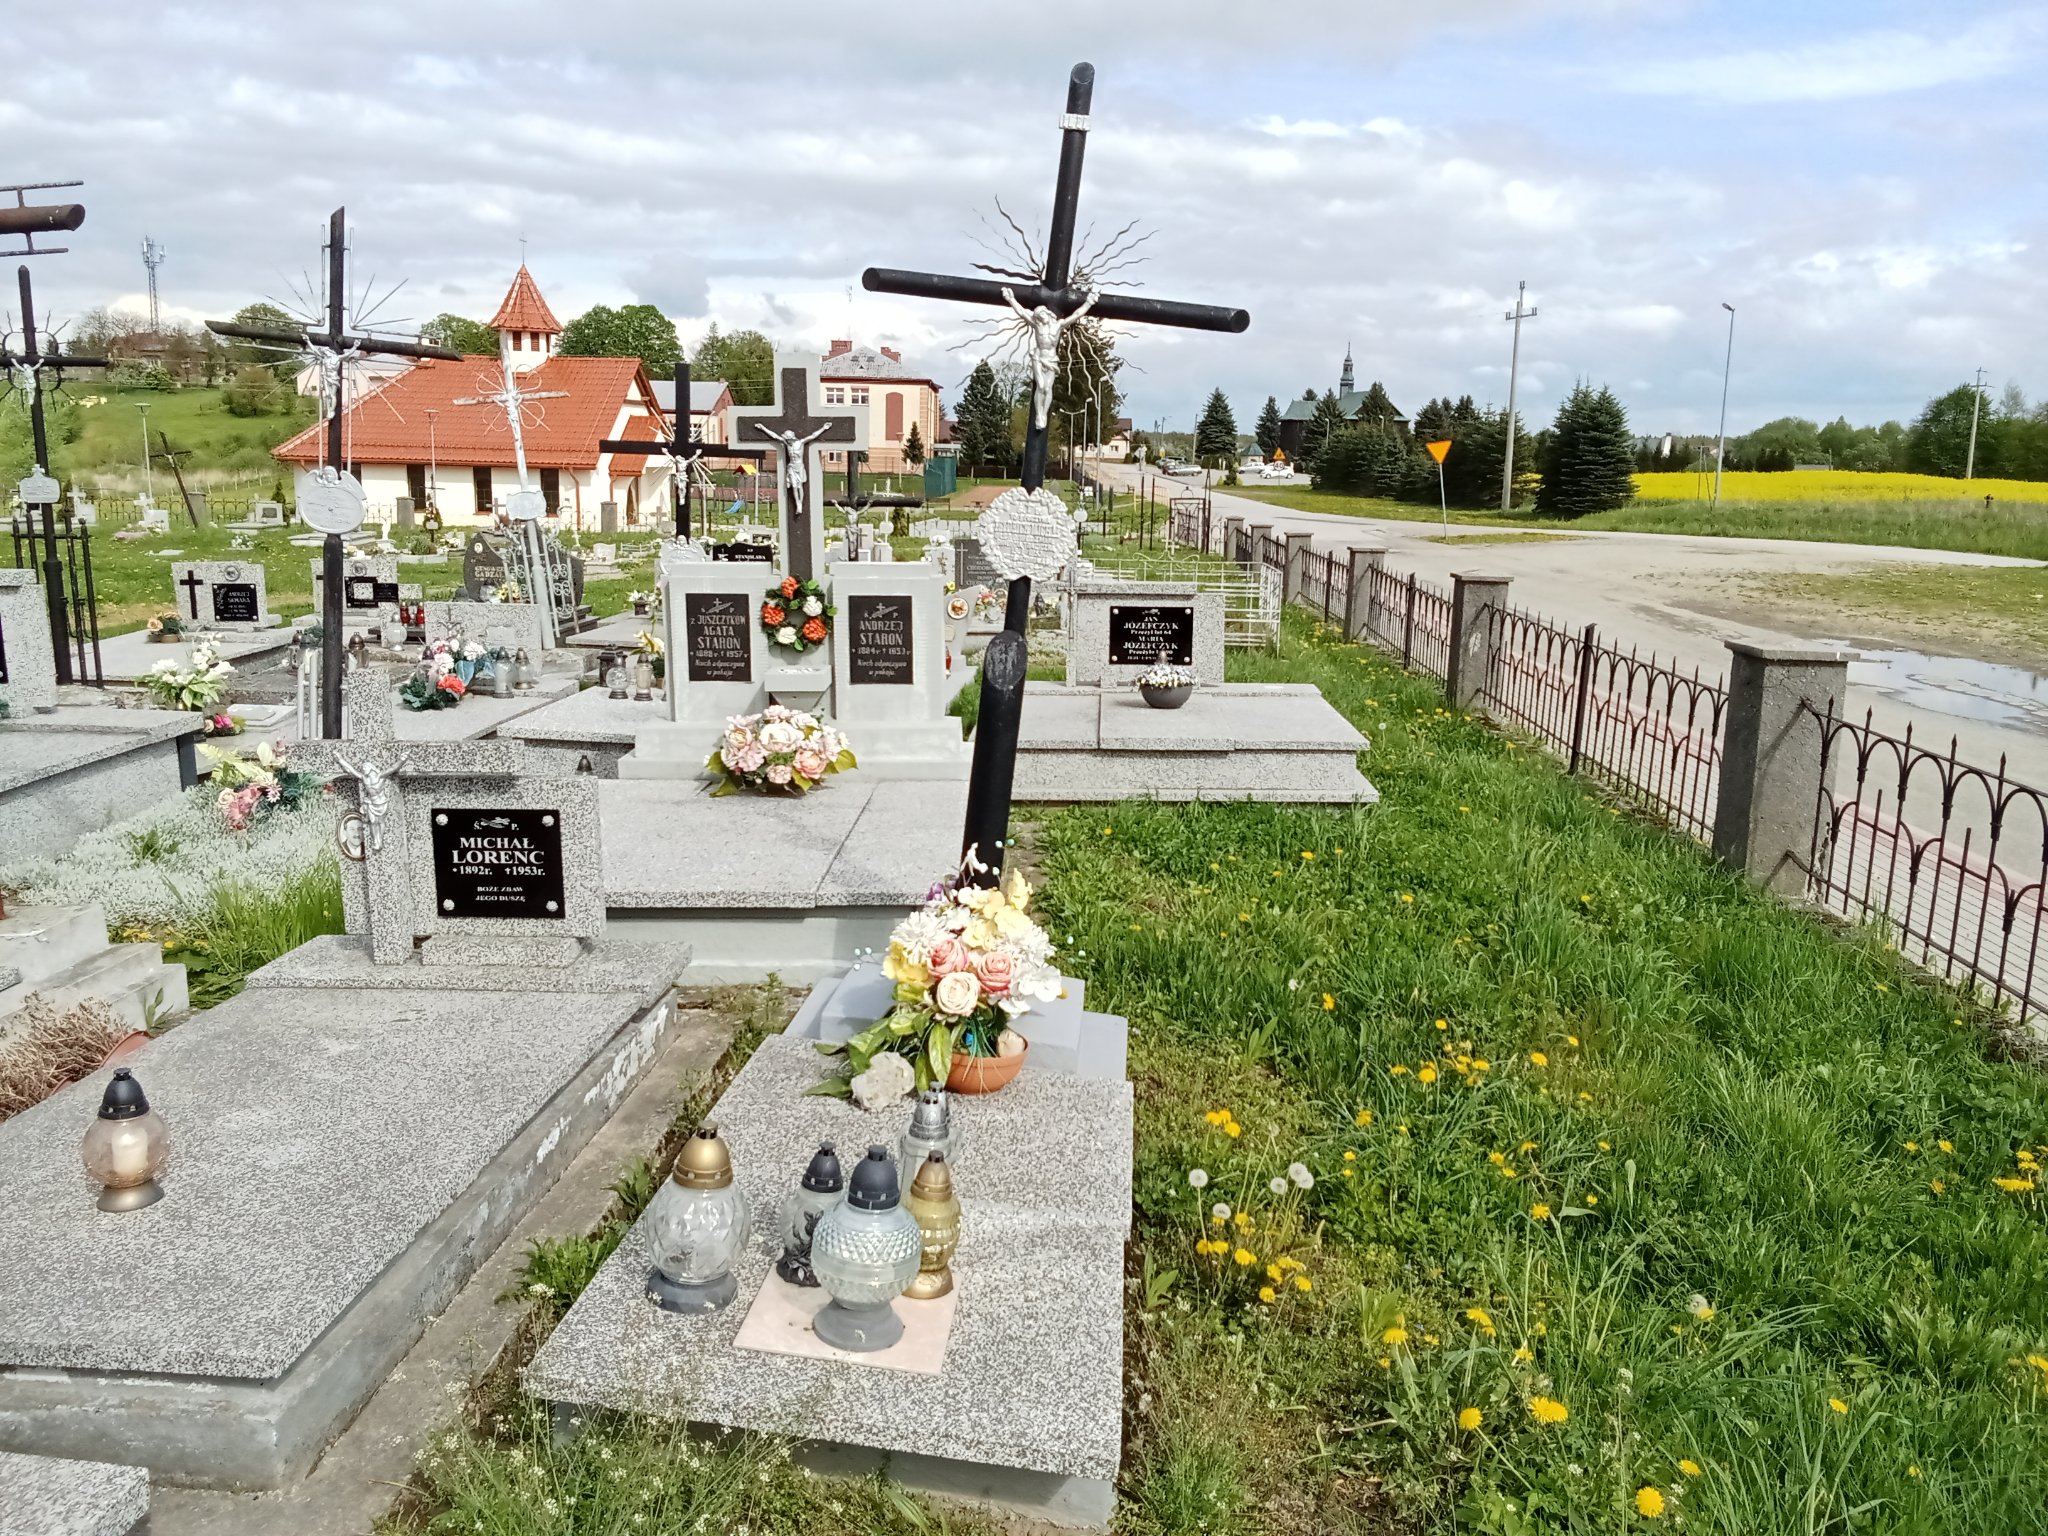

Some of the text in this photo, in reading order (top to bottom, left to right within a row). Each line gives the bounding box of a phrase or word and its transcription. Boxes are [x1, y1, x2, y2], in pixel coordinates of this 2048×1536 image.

[703, 625, 735, 636] AGATA
[859, 620, 904, 631] ANDRZEJ
[459, 836, 535, 849] MICHAŁ
[451, 849, 545, 865] LORENC
